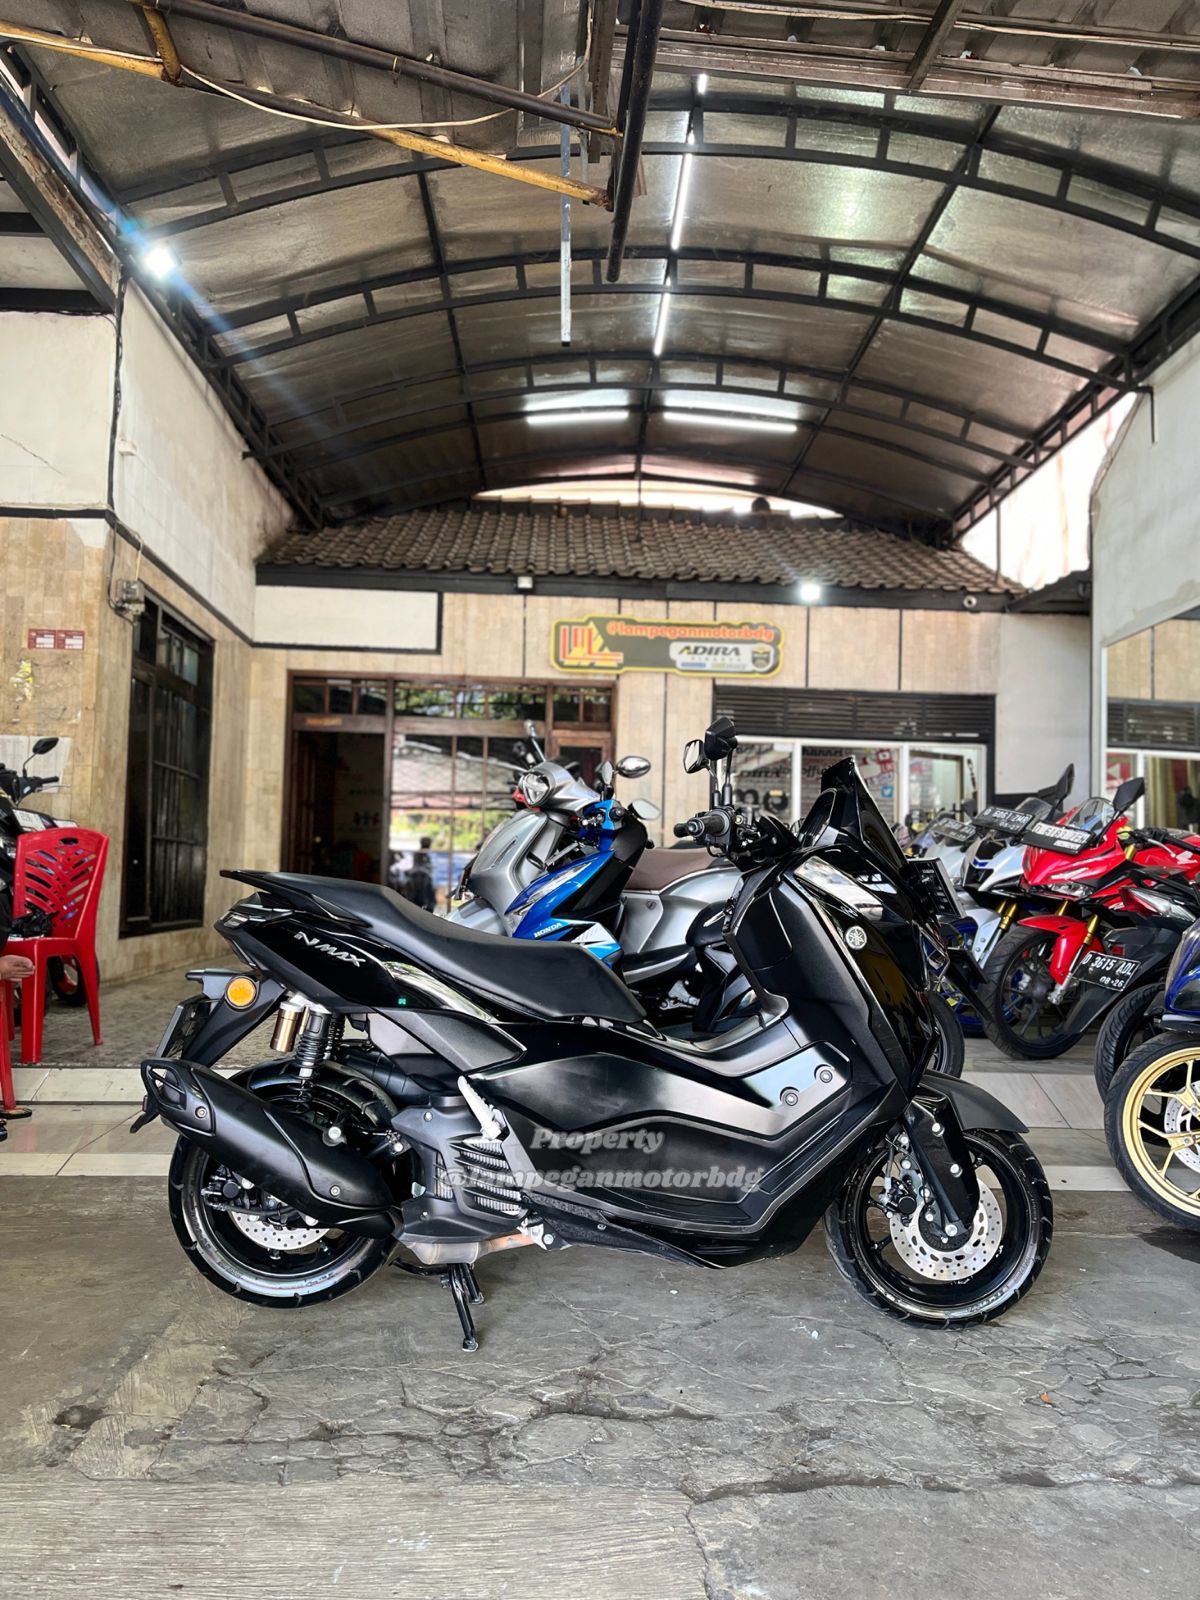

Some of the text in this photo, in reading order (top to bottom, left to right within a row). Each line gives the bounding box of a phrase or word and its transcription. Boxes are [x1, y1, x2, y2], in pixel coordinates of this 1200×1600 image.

[679, 645, 741, 656] ADIRA
[534, 922, 562, 938] HONDA
[293, 931, 366, 967] NMAX
[1082, 953, 1093, 965] D
[1091, 956, 1116, 971] 3615
